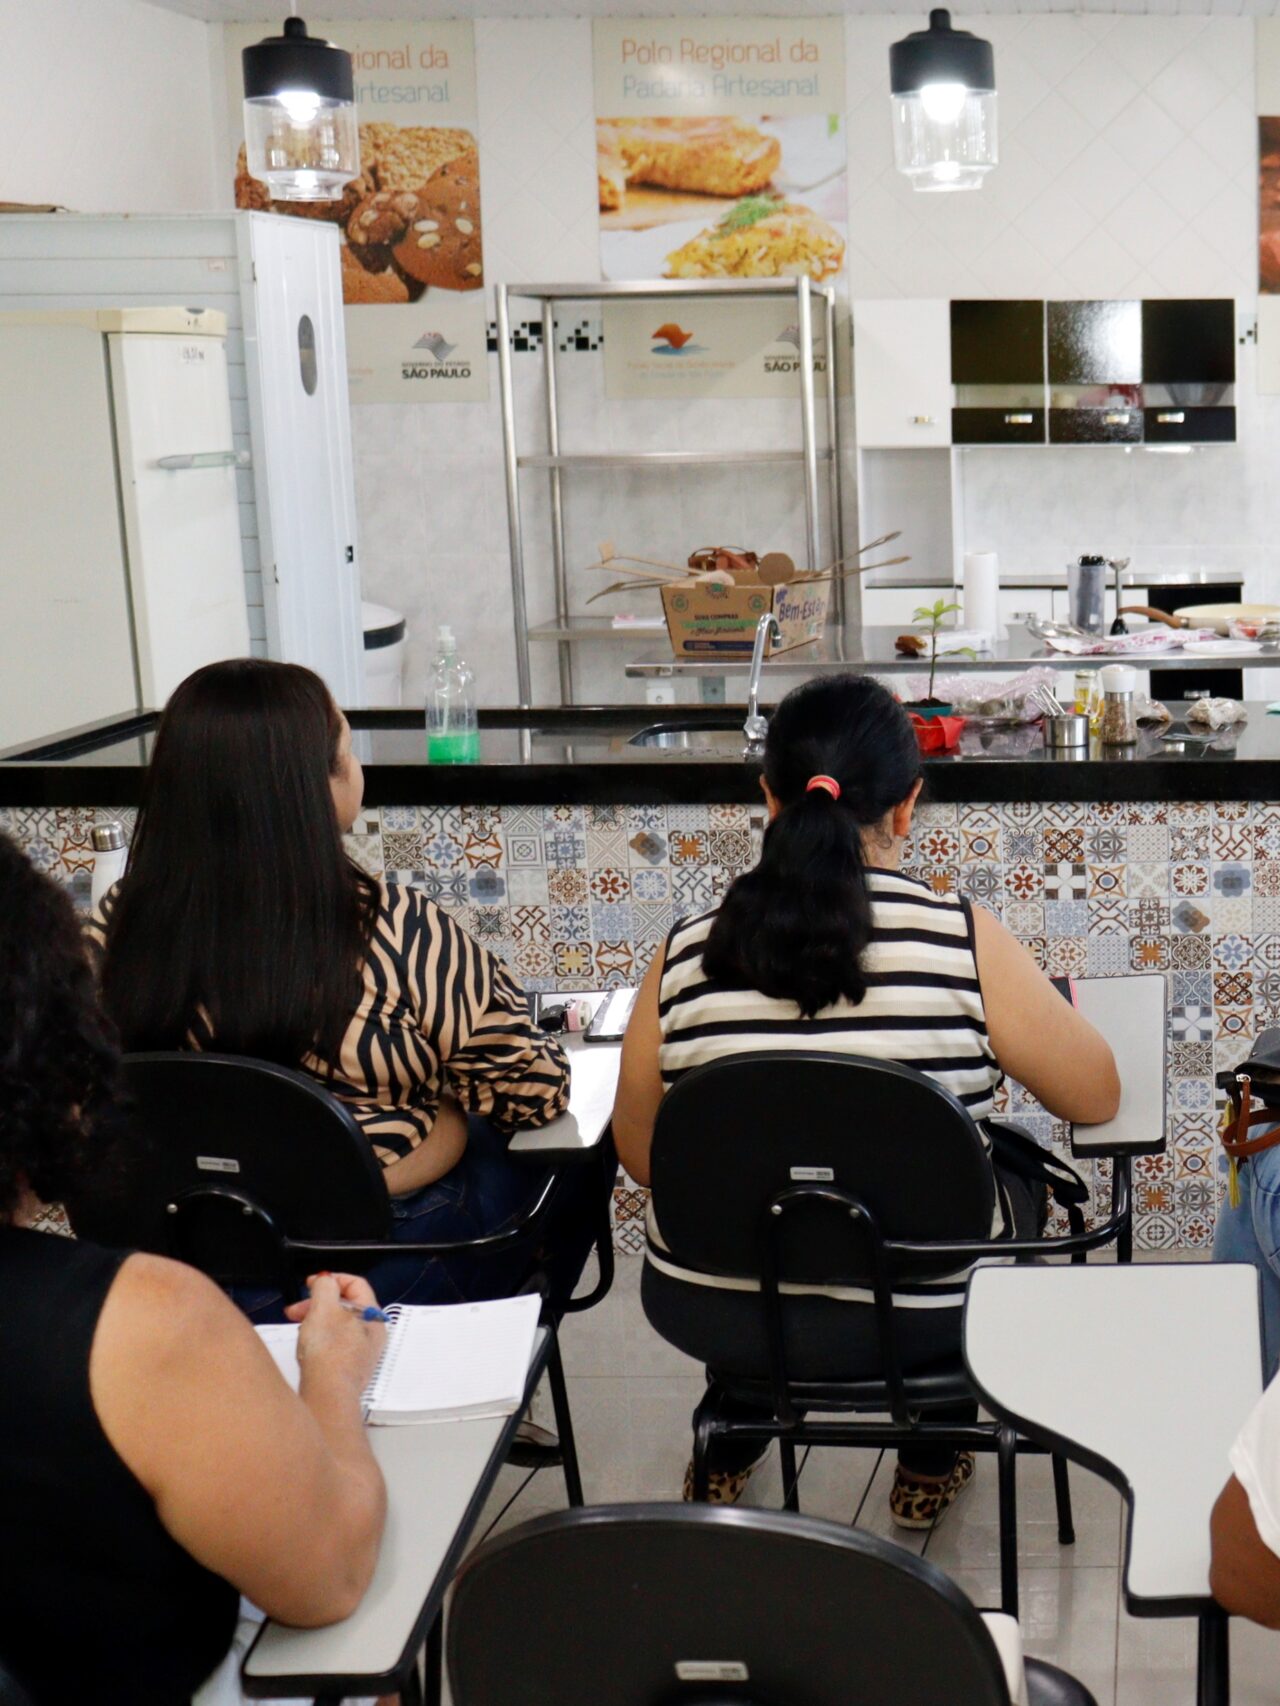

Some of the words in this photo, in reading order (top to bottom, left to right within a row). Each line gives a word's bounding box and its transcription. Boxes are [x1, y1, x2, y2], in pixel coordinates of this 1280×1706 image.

[351, 43, 412, 71] ional
[420, 42, 449, 69] da
[622, 38, 673, 65] Polo
[680, 37, 782, 70] Regional
[790, 37, 819, 64] da
[712, 73, 820, 98] Artesanal
[402, 366, 429, 380] SÃO
[430, 367, 472, 379] PAULO
